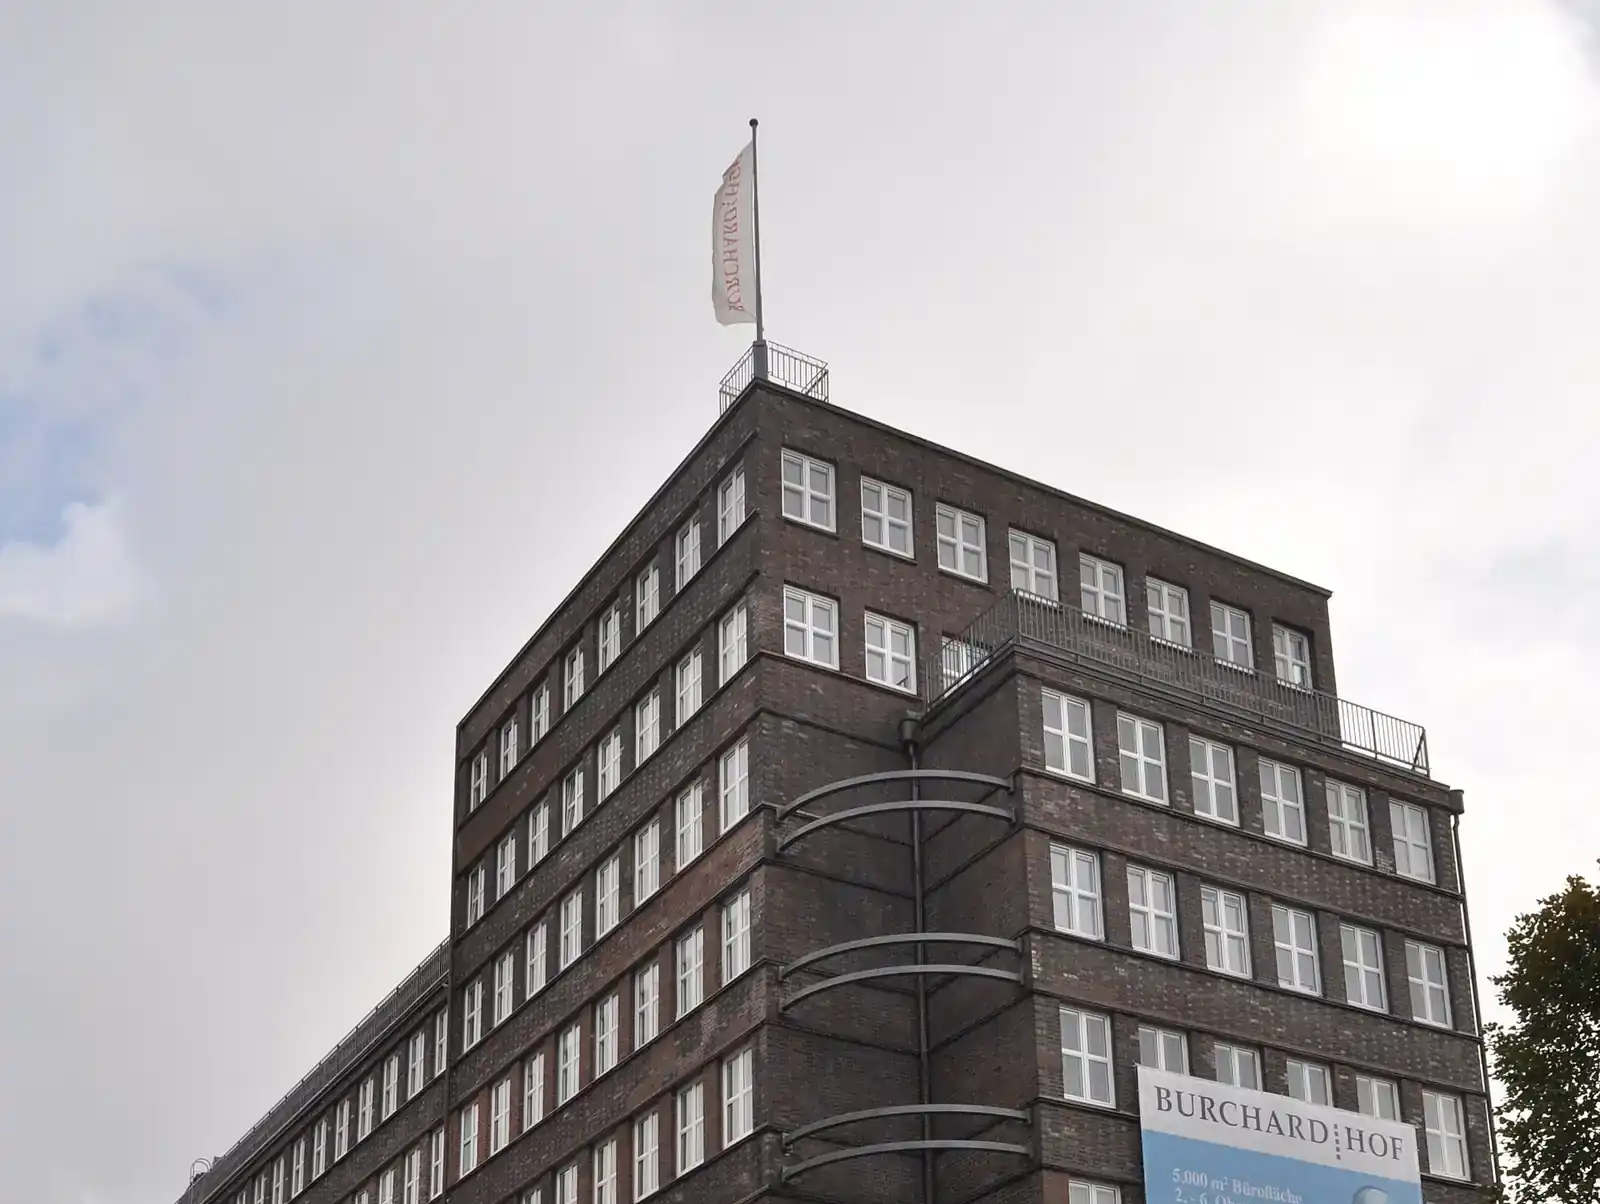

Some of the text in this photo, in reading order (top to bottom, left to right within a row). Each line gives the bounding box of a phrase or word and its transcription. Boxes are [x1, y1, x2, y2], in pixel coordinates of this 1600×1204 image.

[1154, 1085, 1403, 1160] BURCHARD HOF
[1172, 1168, 1208, 1188] 5.000
[1232, 1179, 1303, 1204] Bürofläche
